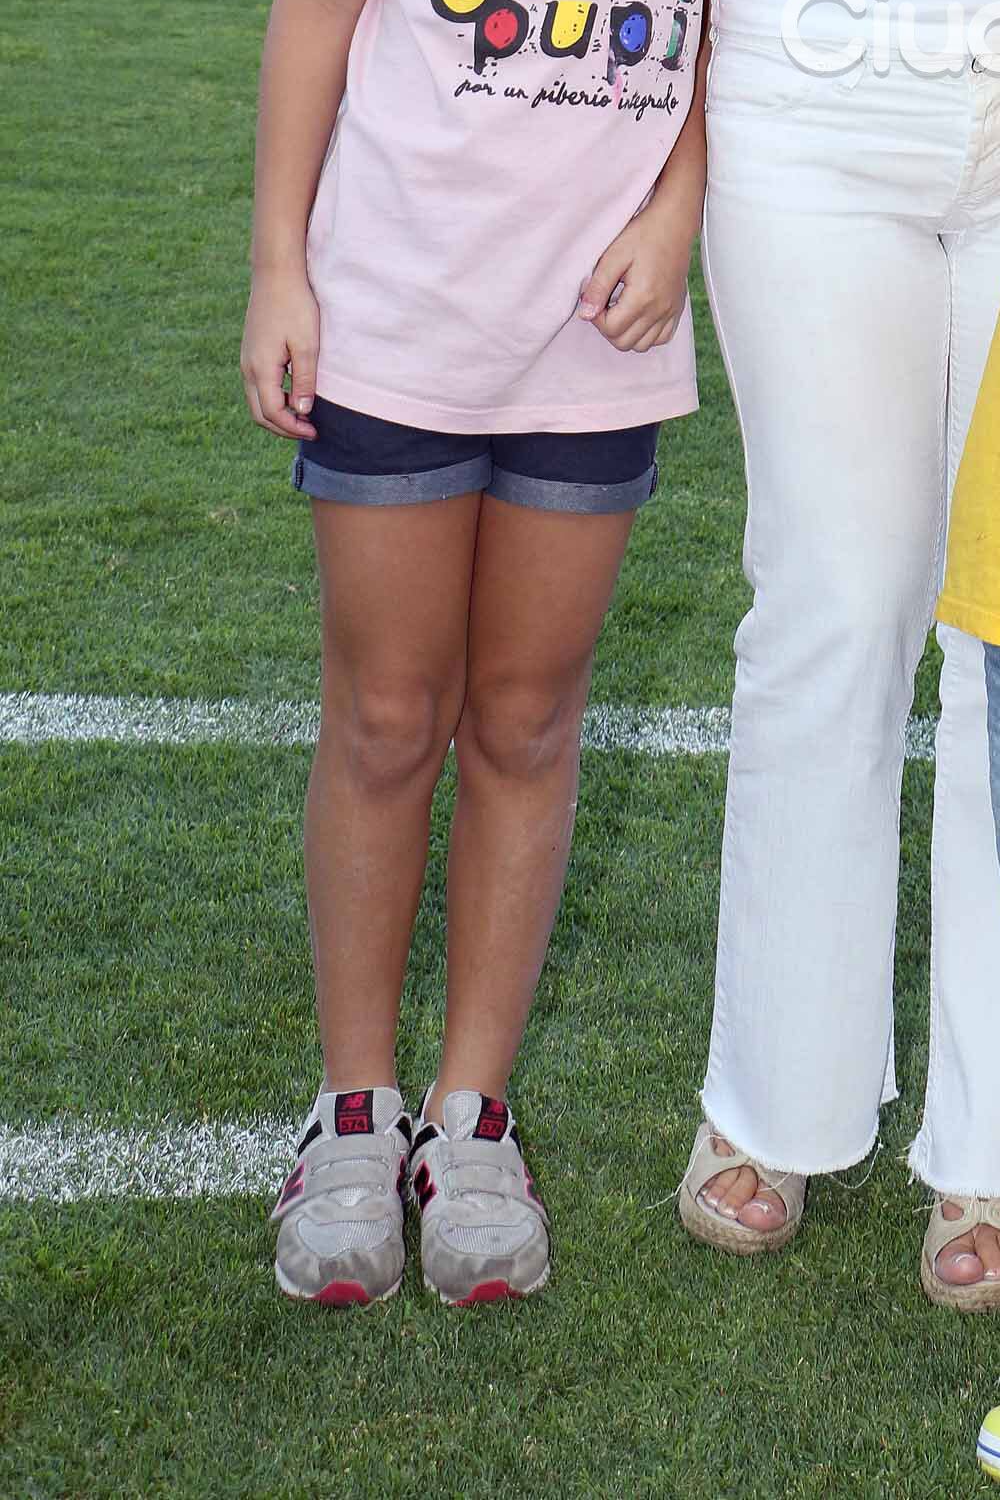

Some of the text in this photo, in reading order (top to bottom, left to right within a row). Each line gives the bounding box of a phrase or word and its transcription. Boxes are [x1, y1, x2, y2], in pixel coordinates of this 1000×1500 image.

[454, 79, 496, 97] por
[503, 86, 529, 100] un
[617, 82, 679, 122] integrado
